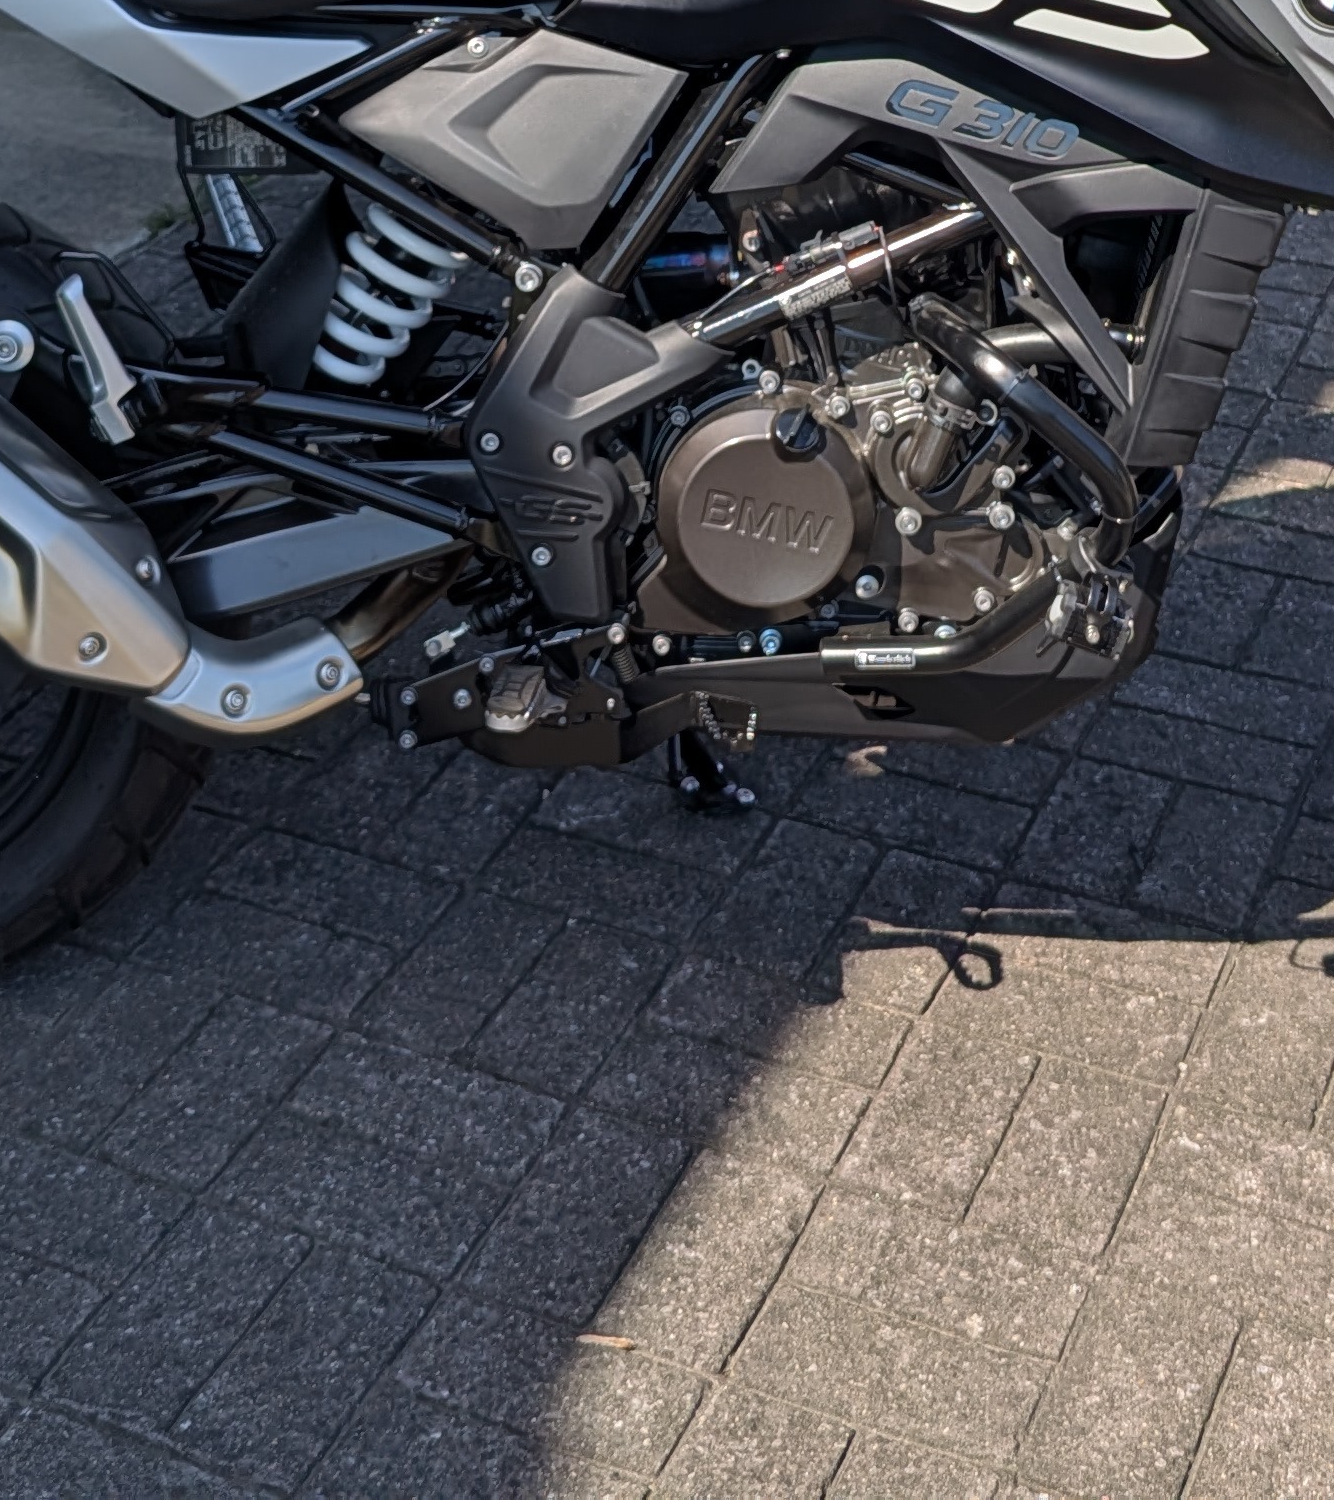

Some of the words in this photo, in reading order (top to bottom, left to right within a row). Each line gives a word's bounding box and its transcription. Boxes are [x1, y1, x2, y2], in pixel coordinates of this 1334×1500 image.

[885, 79, 960, 129] G
[952, 99, 1080, 160] 310
[700, 488, 835, 554] BMW
